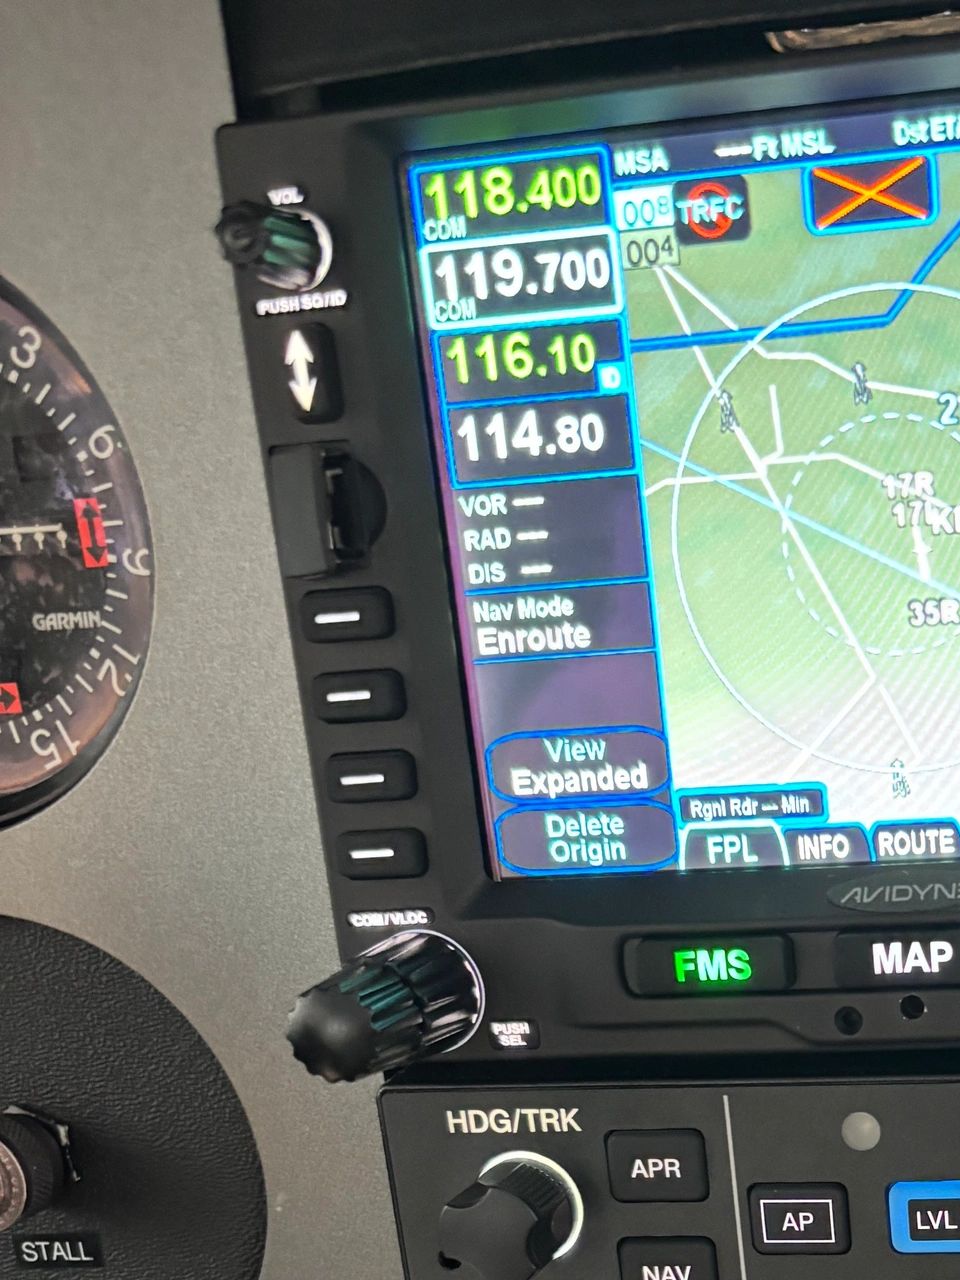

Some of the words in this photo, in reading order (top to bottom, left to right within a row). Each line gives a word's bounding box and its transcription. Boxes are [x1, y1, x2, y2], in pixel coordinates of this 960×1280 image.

[782, 130, 835, 157] MSL
[614, 147, 669, 176] MSA
[425, 165, 601, 220] 118.400
[676, 195, 744, 224] TRFC
[423, 216, 466, 241] COM
[626, 235, 673, 267] 004
[435, 247, 610, 300] 119.700
[435, 297, 476, 322] COM
[446, 332, 596, 384] 116.10
[457, 410, 605, 462] 114.80
[458, 493, 508, 516] VOR
[463, 527, 511, 551] RAD
[468, 563, 506, 584] DIS
[32, 611, 101, 631] GARMIN
[472, 600, 513, 623] Nav
[517, 595, 574, 618] Mode
[477, 622, 592, 655] Enroute
[543, 737, 606, 763] View
[510, 761, 648, 799] Expanded
[730, 797, 758, 816] Rdr
[781, 795, 809, 814] Min
[545, 812, 624, 838] Delete
[550, 838, 627, 864] Origin
[707, 835, 758, 864] FPL
[798, 833, 849, 860] INFO
[878, 828, 954, 856] ROUTE
[674, 949, 752, 982] FMS
[872, 941, 953, 975] MAP
[446, 1108, 582, 1134] HDG/TRK
[631, 1159, 681, 1178] APR
[782, 1212, 814, 1231] AP
[916, 1210, 958, 1230] LVL
[21, 1242, 94, 1262] STALL
